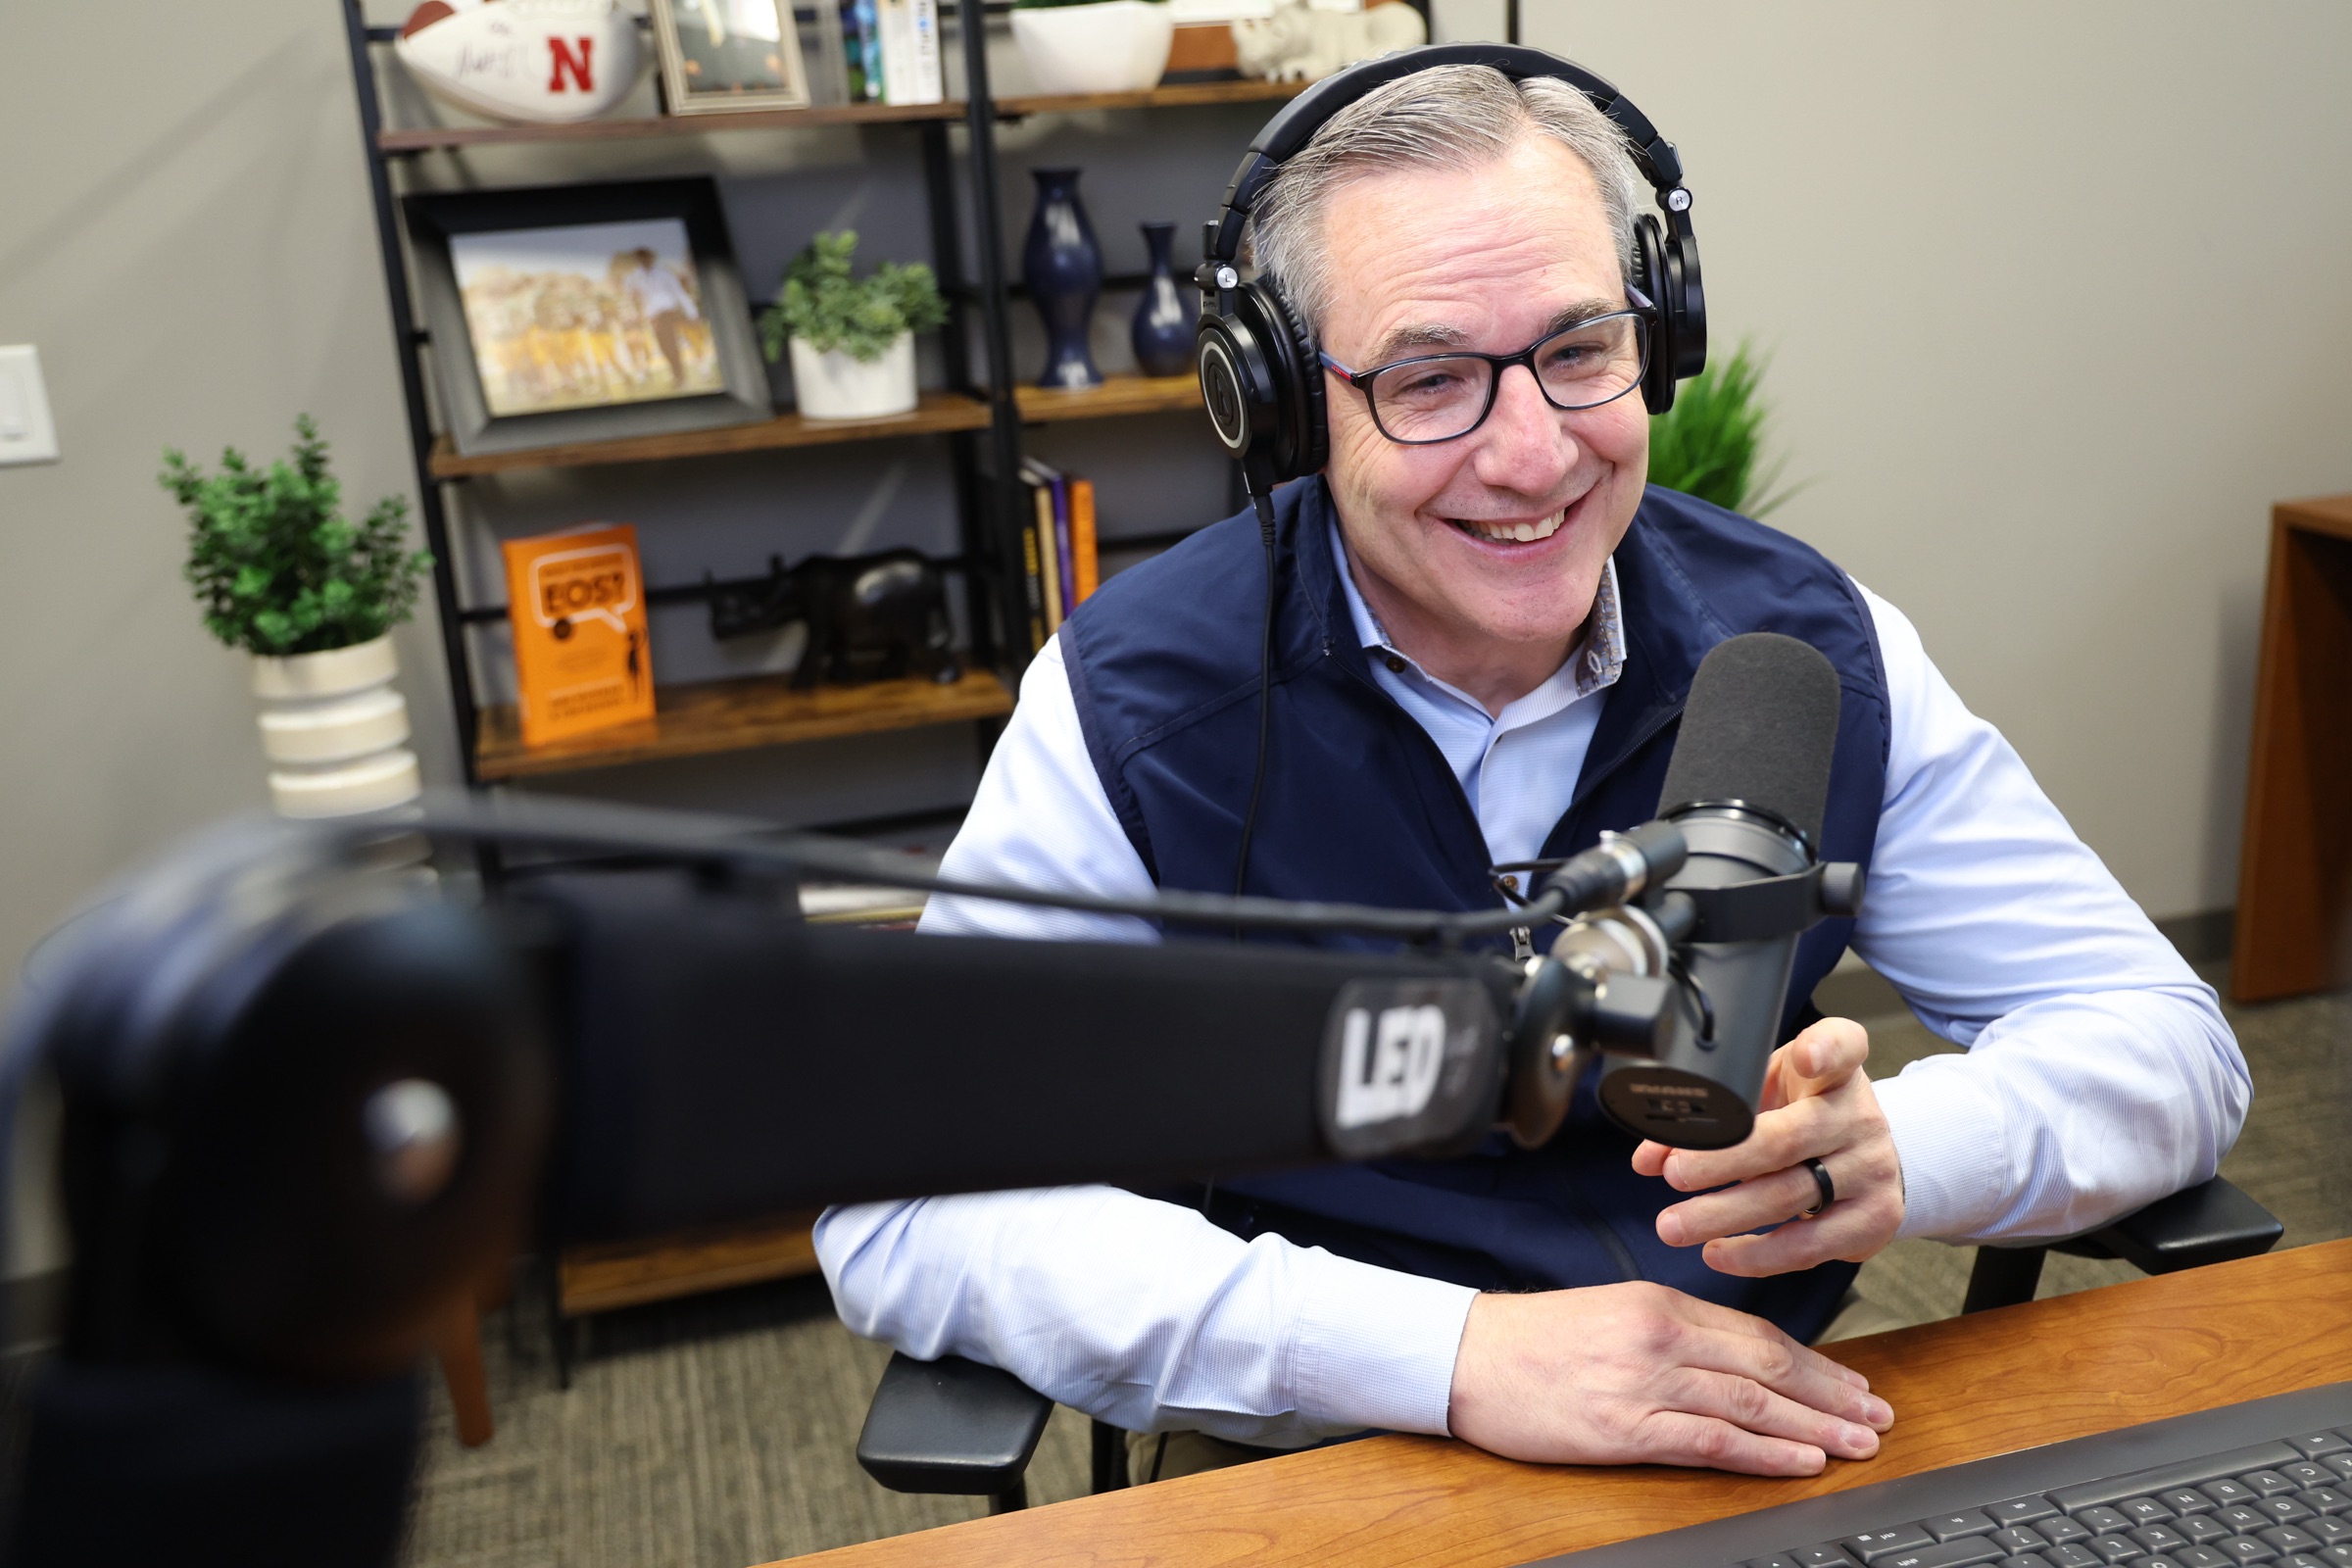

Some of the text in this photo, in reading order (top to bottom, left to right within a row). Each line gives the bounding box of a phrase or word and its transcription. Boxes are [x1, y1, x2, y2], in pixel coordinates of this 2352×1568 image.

[548, 36, 594, 93] N
[1675, 196, 1684, 206] R
[1225, 274, 1231, 283] L
[2178, 1494, 2194, 1503] N
[2321, 1493, 2332, 1501] F
[2135, 1503, 2153, 1512] M
[2232, 1511, 2250, 1520] H
[2192, 1521, 2203, 1530] J
[2325, 1523, 2339, 1532] T
[1880, 1532, 1896, 1541] ctrl
[2149, 1531, 2166, 1540] K
[2282, 1533, 2297, 1542] Y
[2237, 1543, 2254, 1551] U
[1896, 1557, 1919, 1566] shift
